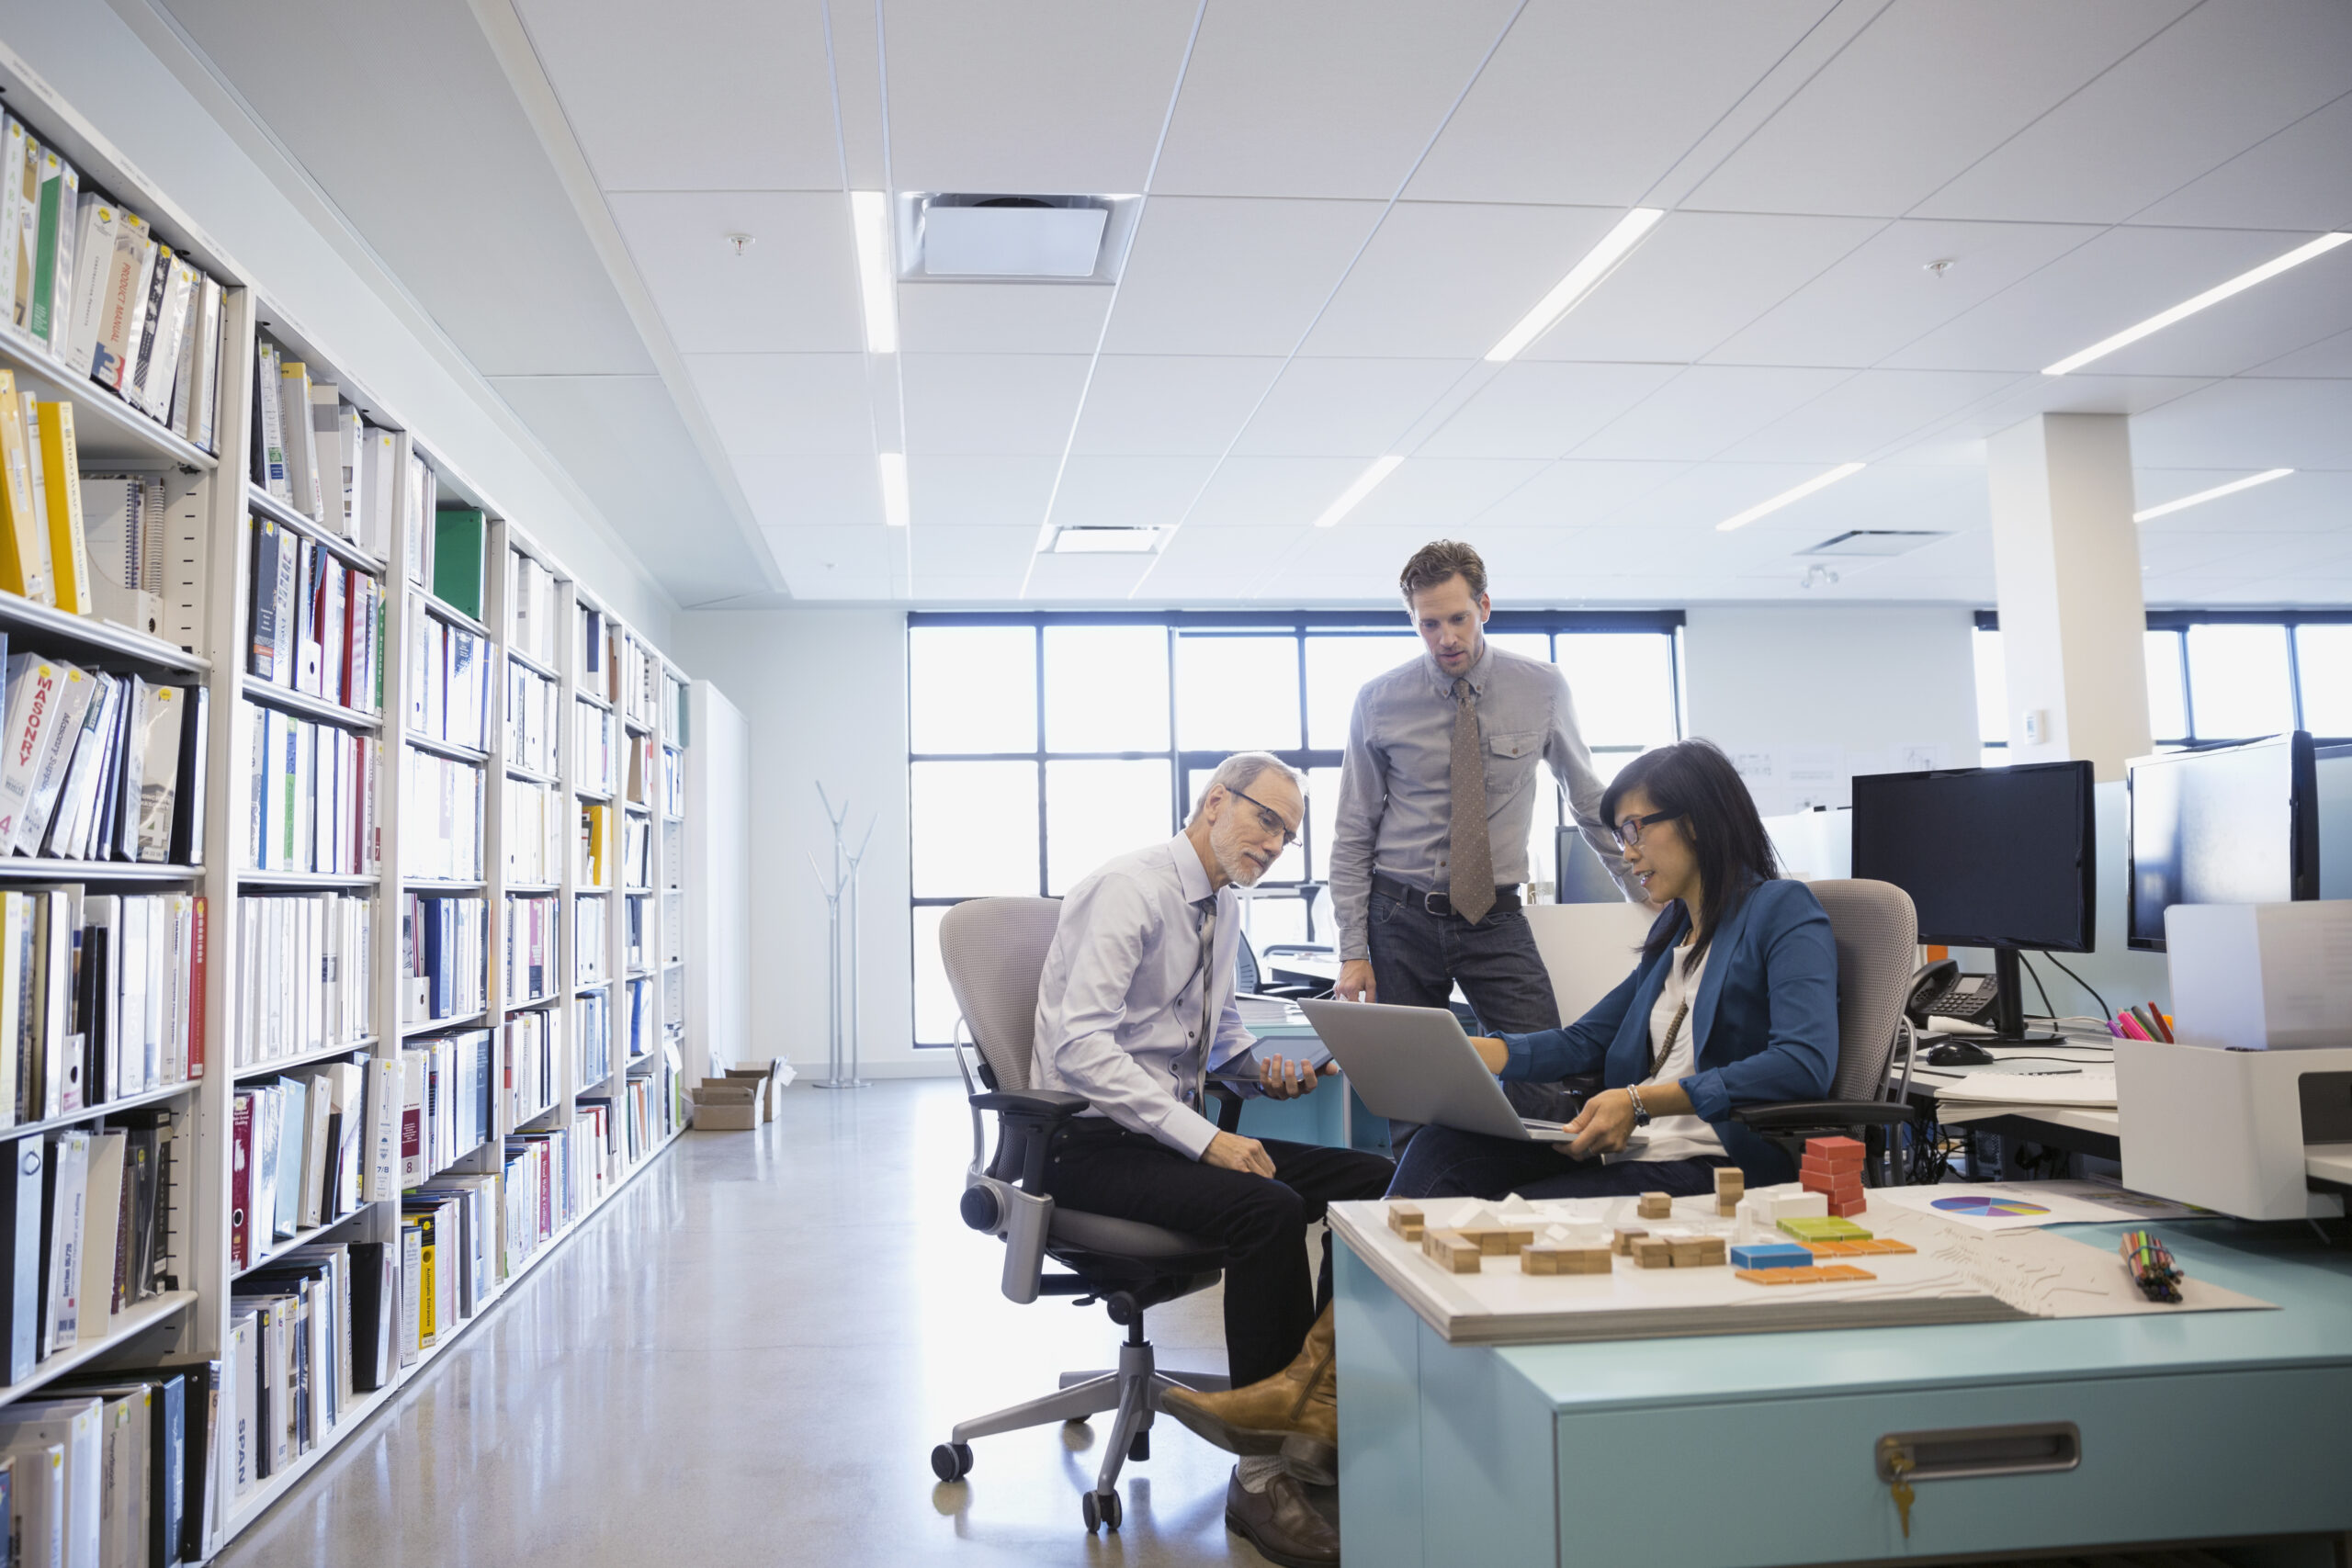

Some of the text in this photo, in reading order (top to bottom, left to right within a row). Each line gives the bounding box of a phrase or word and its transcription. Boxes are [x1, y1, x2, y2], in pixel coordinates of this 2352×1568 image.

[110, 262, 131, 343] PRODUCT MANUAL
[19, 674, 52, 768] MASONRY
[51, 712, 72, 757] Masonry
[0, 814, 13, 836] 4
[140, 812, 168, 848] 4
[377, 1166, 390, 1174] 7/8
[406, 1162, 413, 1173] 8
[212, 1393, 219, 1408] 6
